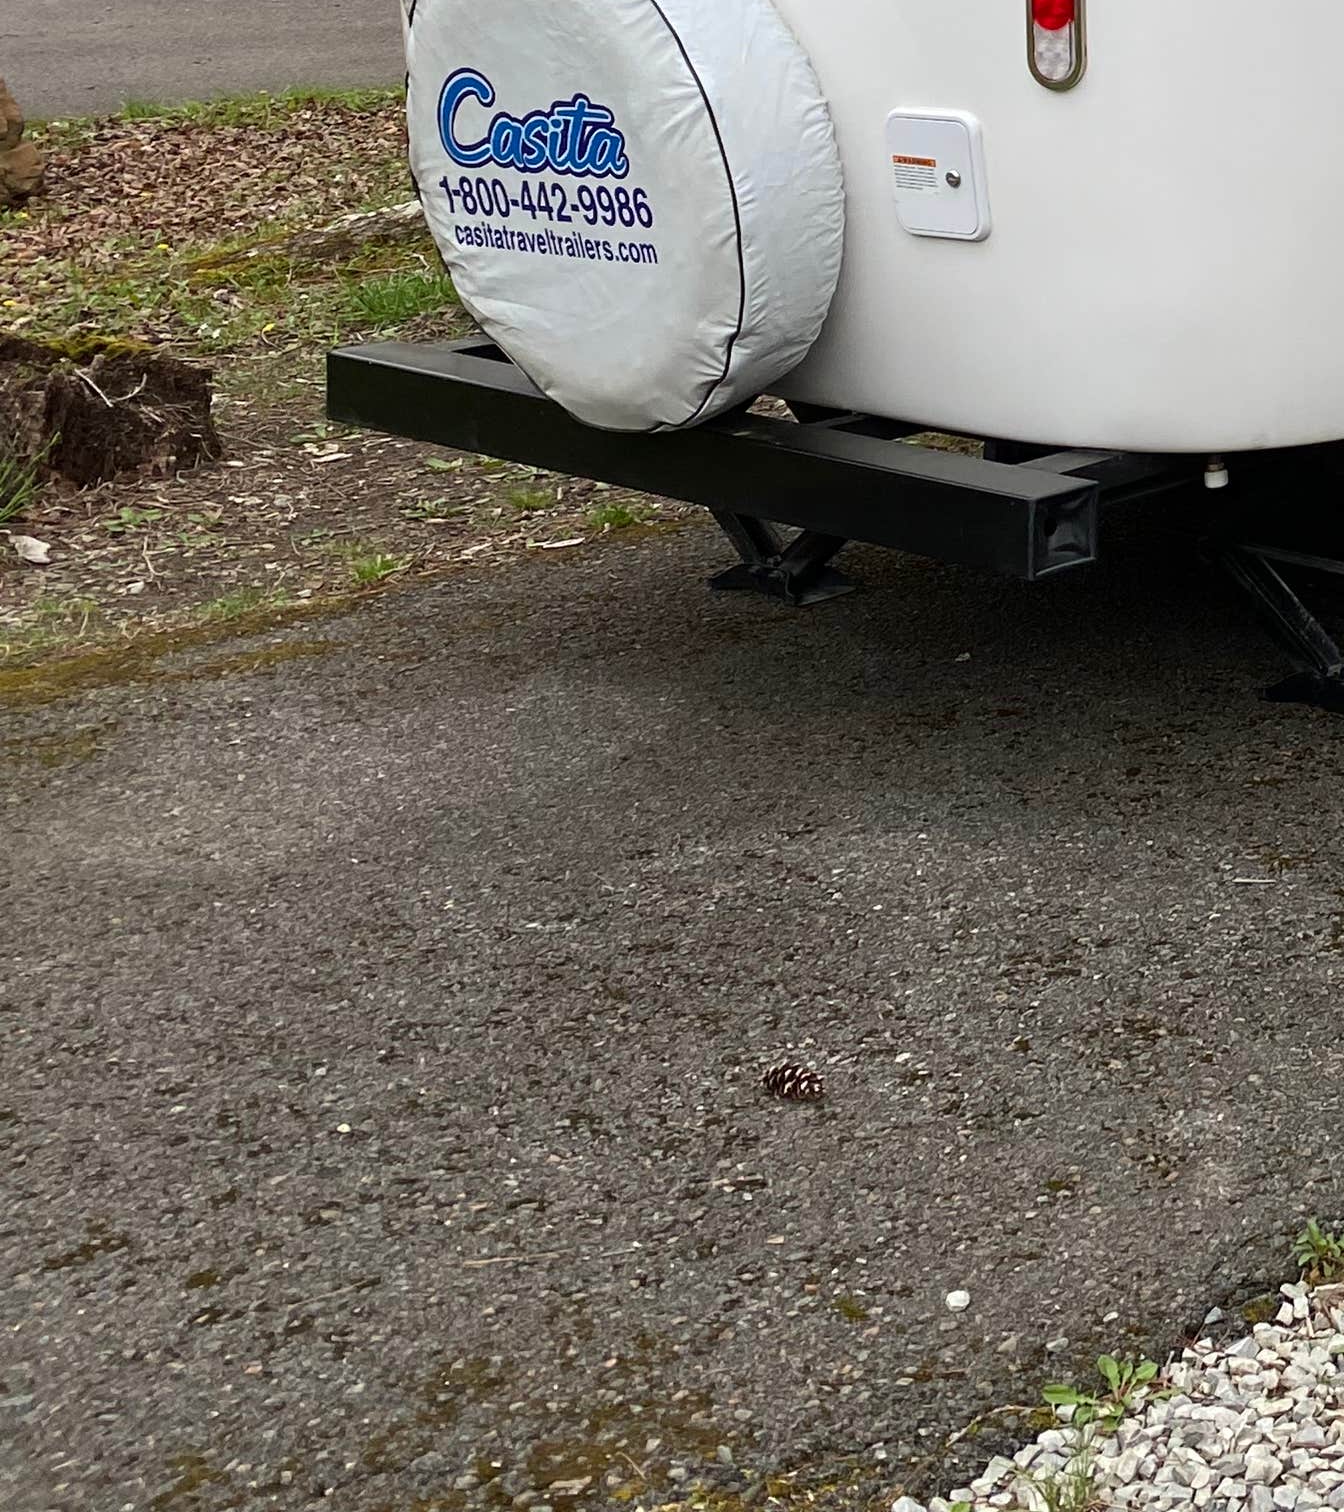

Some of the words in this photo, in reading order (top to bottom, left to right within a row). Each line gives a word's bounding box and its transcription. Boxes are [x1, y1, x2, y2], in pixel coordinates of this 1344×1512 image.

[437, 67, 630, 179] Casita
[439, 176, 653, 228] 1-800-442-9986
[455, 221, 658, 264] casitatraveltrailers.com
